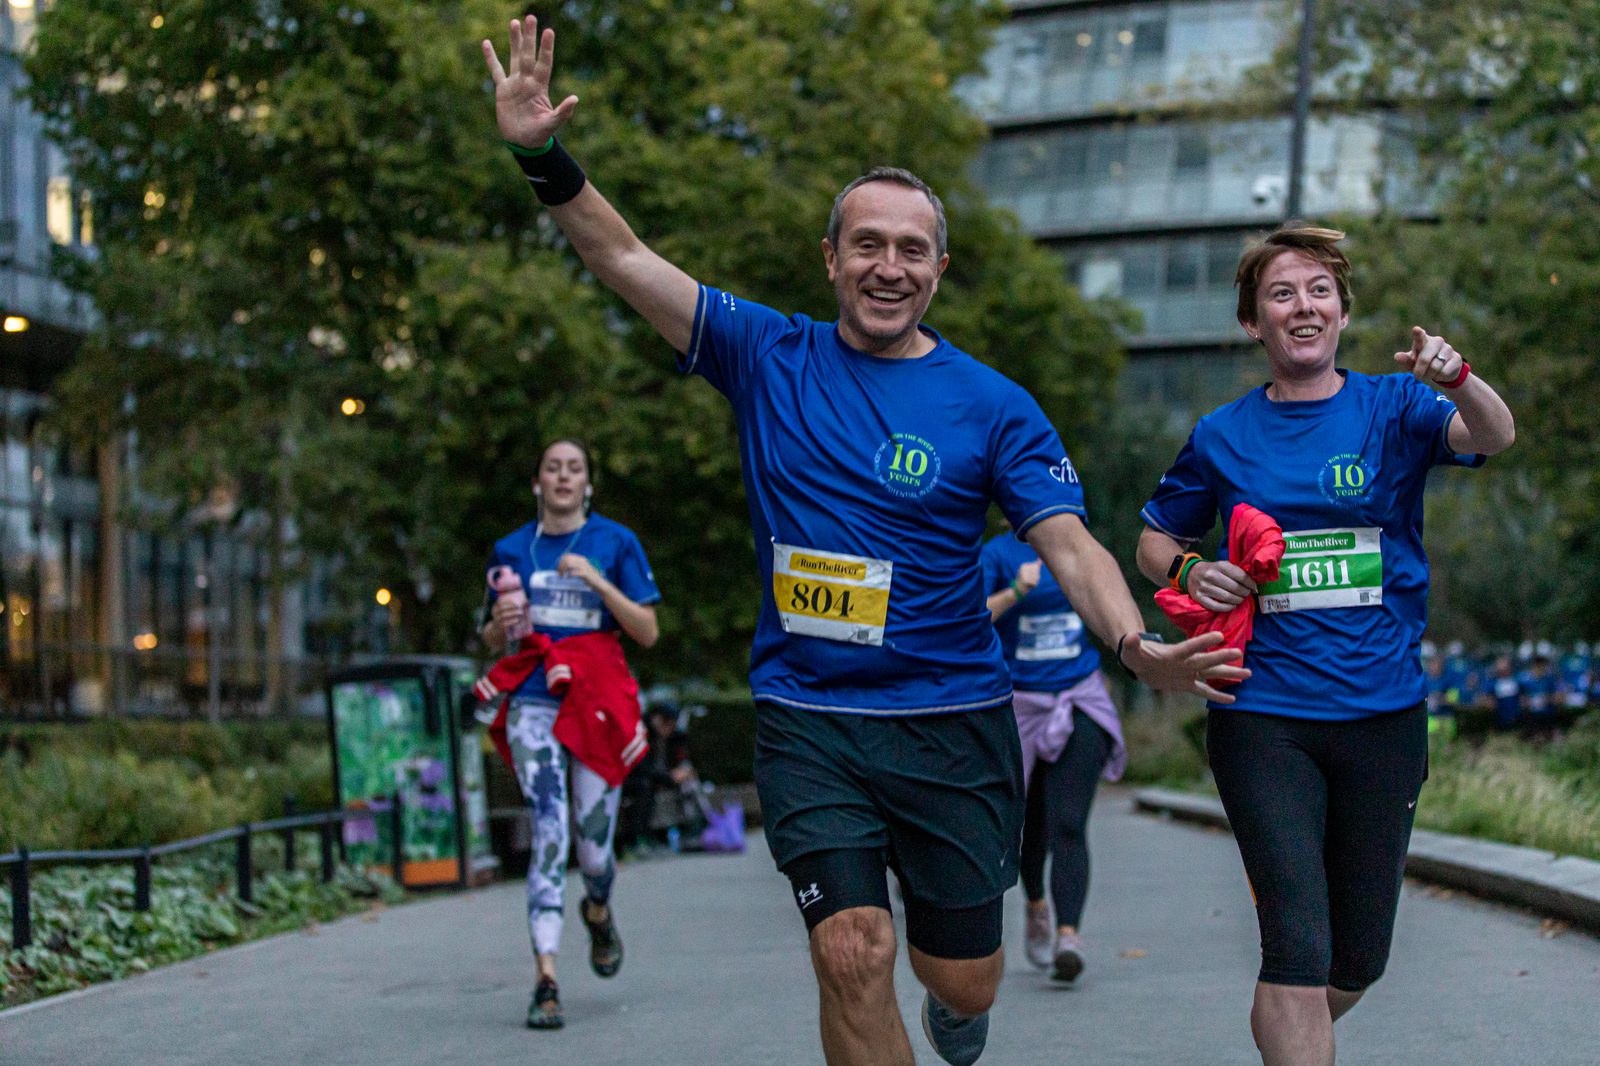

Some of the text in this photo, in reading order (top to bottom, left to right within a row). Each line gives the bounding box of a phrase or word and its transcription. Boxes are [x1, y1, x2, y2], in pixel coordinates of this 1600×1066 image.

[888, 443, 928, 477] 10
[888, 471, 921, 487] years
[1332, 464, 1365, 488] 10
[1335, 488, 1365, 500] years
[1289, 537, 1349, 550] RunTheRiver
[799, 557, 858, 576] RunTheRiver
[1287, 559, 1352, 590] 1611
[790, 582, 855, 618] 804
